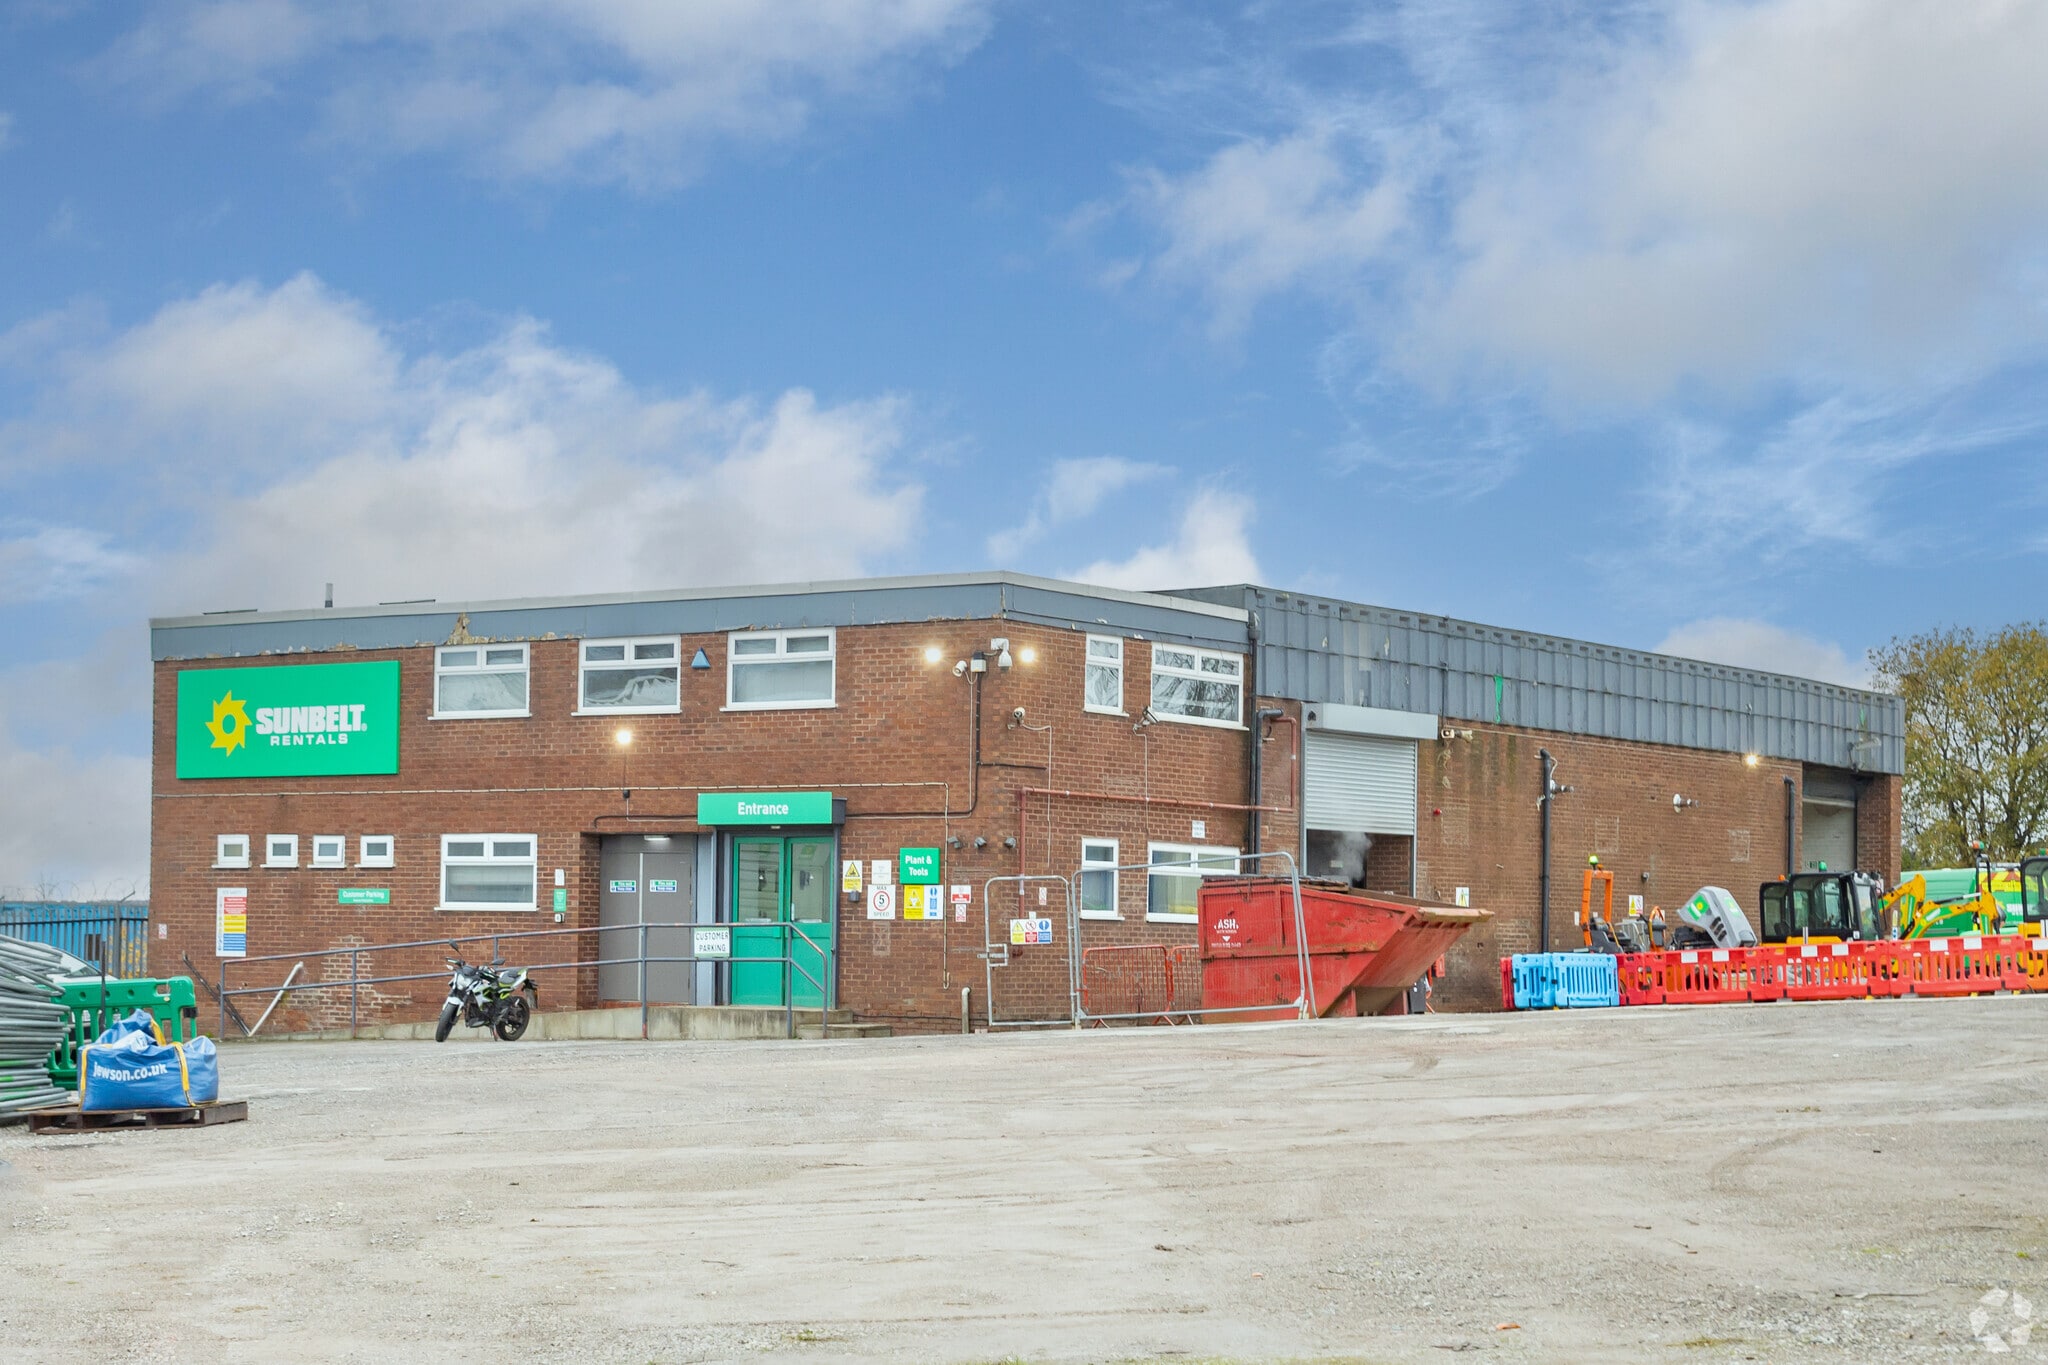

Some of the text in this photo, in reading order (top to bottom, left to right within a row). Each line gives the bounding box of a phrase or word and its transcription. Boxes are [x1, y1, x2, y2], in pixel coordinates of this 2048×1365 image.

[256, 704, 366, 735] SUNBELT
[270, 733, 348, 746] RENTALS
[738, 801, 789, 815] Entrance
[905, 855, 933, 865] Plant &
[908, 866, 929, 876] Tools
[879, 894, 885, 905] 5
[1217, 918, 1236, 930] ASH
[695, 932, 729, 941] CUSTOMER
[699, 944, 726, 952] PARKING
[93, 1061, 168, 1081] jewson.co.uk
